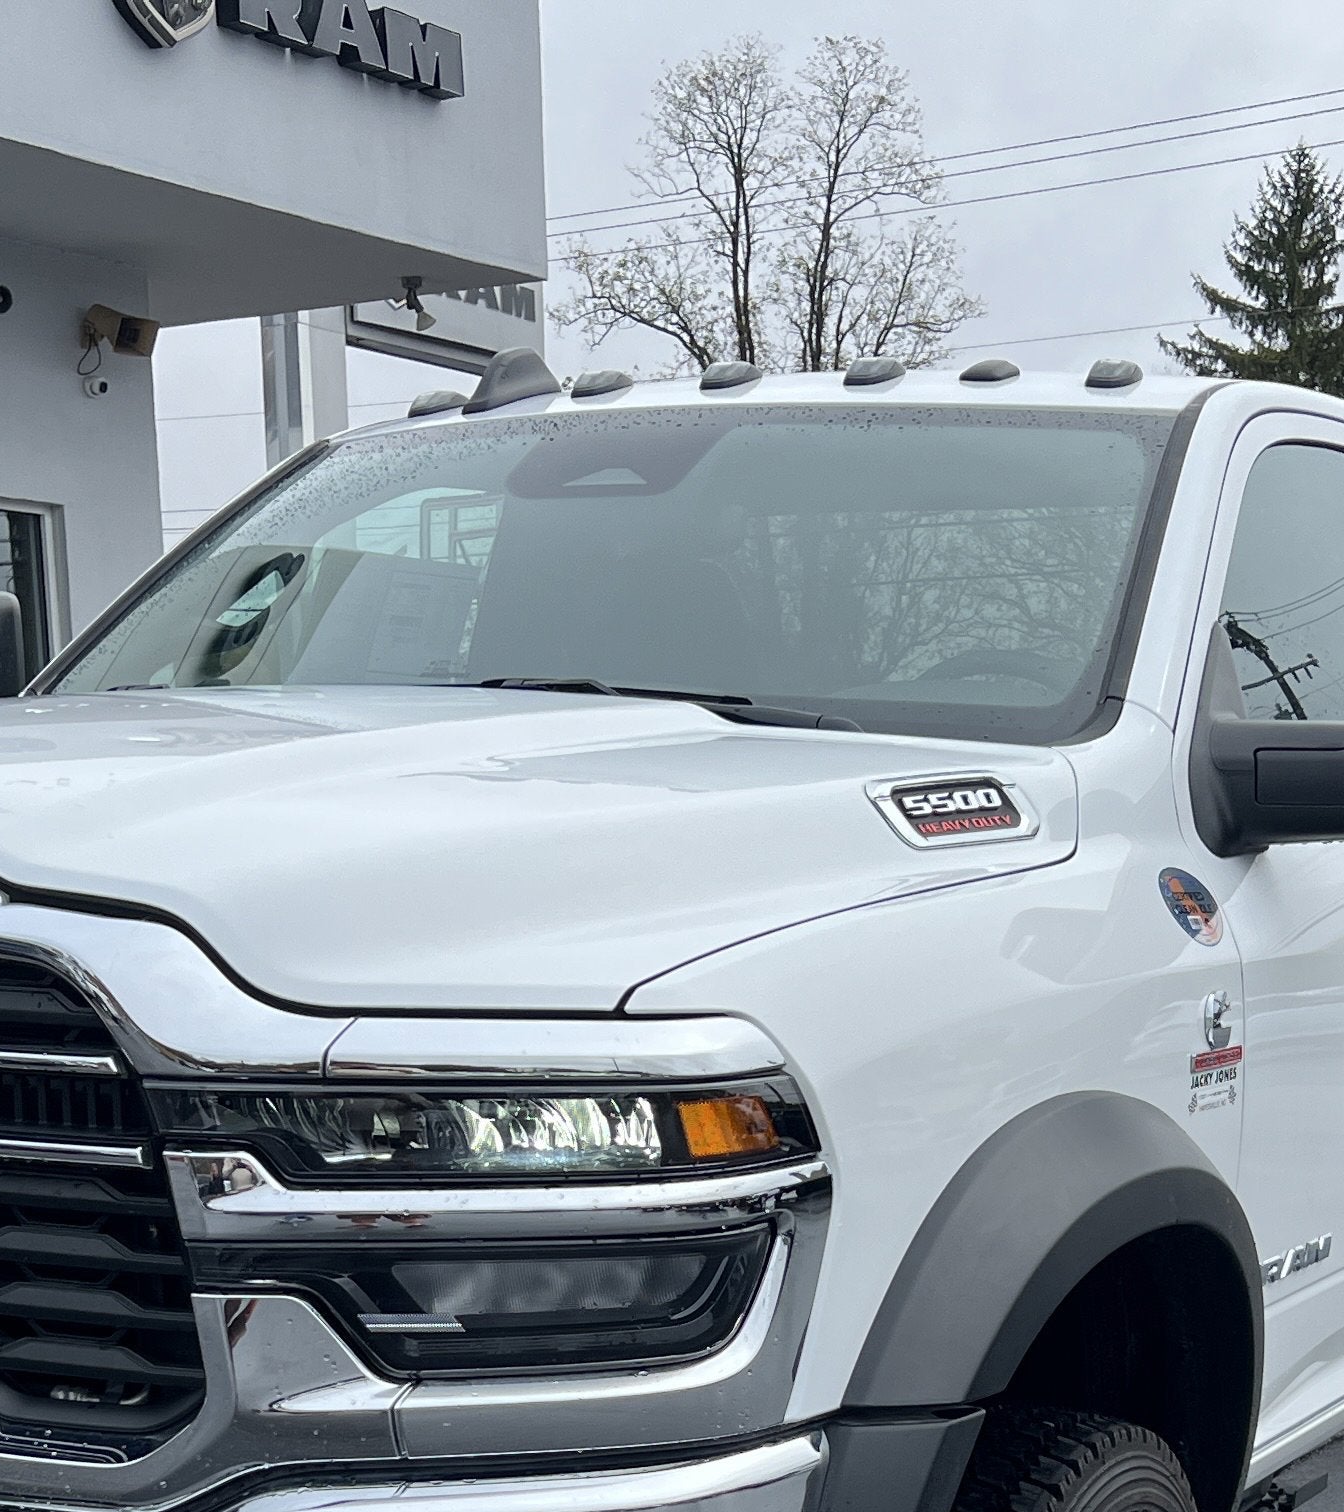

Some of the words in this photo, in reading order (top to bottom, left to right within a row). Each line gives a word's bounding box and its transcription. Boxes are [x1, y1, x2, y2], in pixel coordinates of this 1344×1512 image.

[901, 788, 1003, 817] 5500
[918, 820, 970, 834] HEAVY
[972, 814, 1013, 828] DUTY
[1190, 1071, 1214, 1090] JACKY
[1214, 1066, 1237, 1085] JONES
